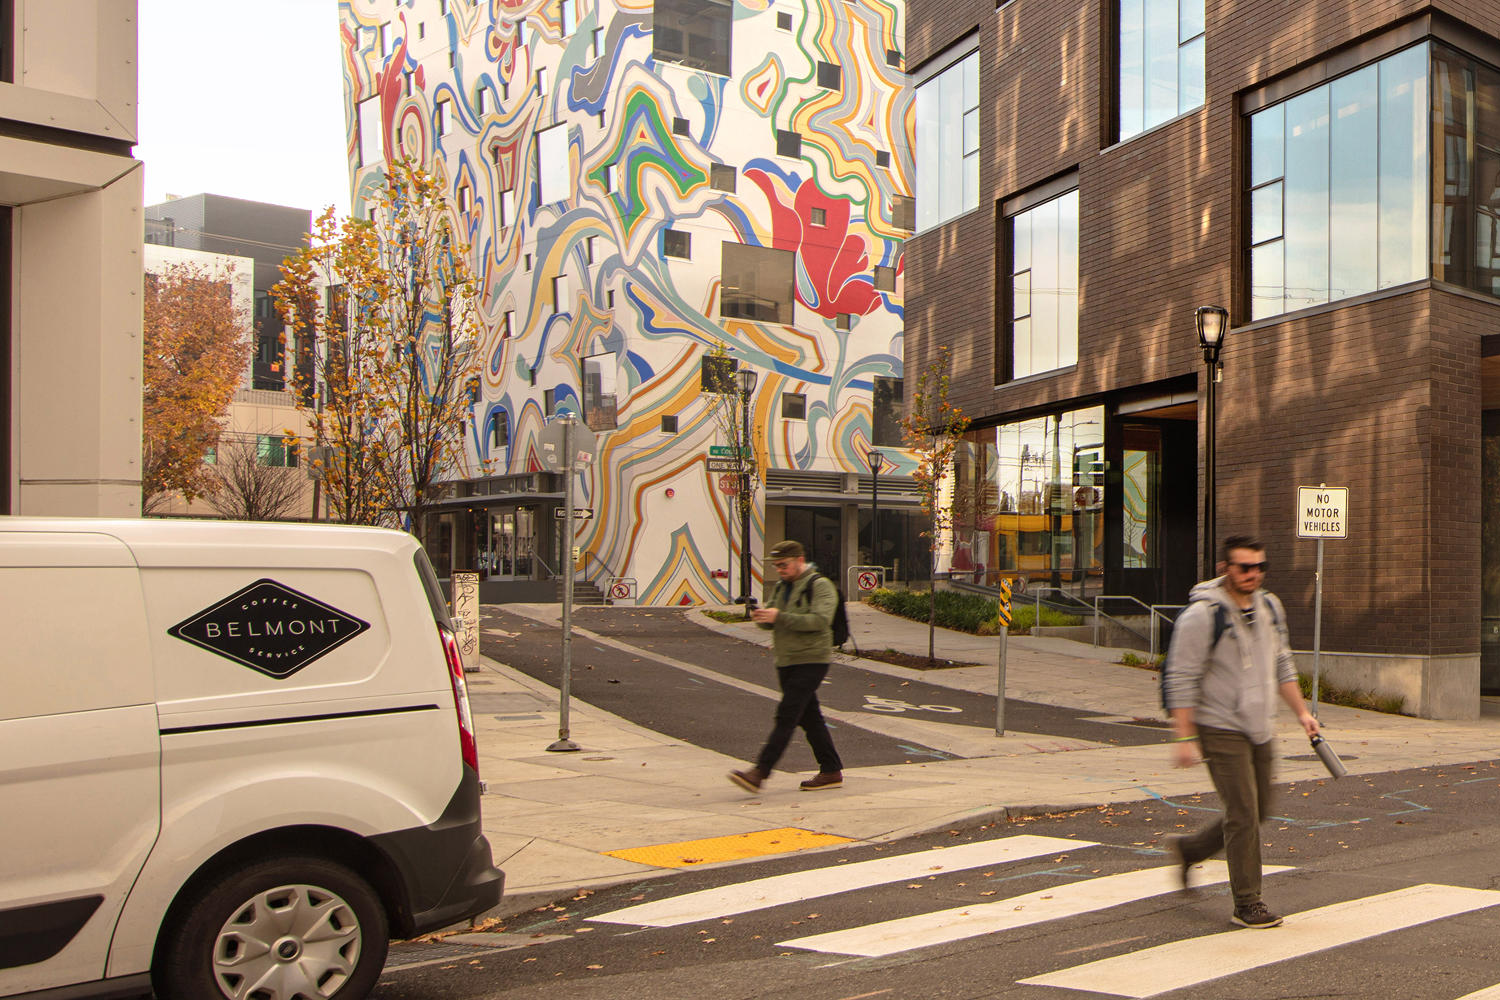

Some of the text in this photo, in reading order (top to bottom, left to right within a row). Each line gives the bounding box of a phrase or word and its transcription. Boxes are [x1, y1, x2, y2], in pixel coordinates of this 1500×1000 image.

[1317, 494, 1330, 504] NO
[1306, 508, 1339, 518] MOTOR
[1304, 521, 1340, 532] VEHICLES
[241, 598, 299, 610] COFFEE
[205, 619, 340, 638] BELMONT
[248, 645, 305, 659] SERVICE
